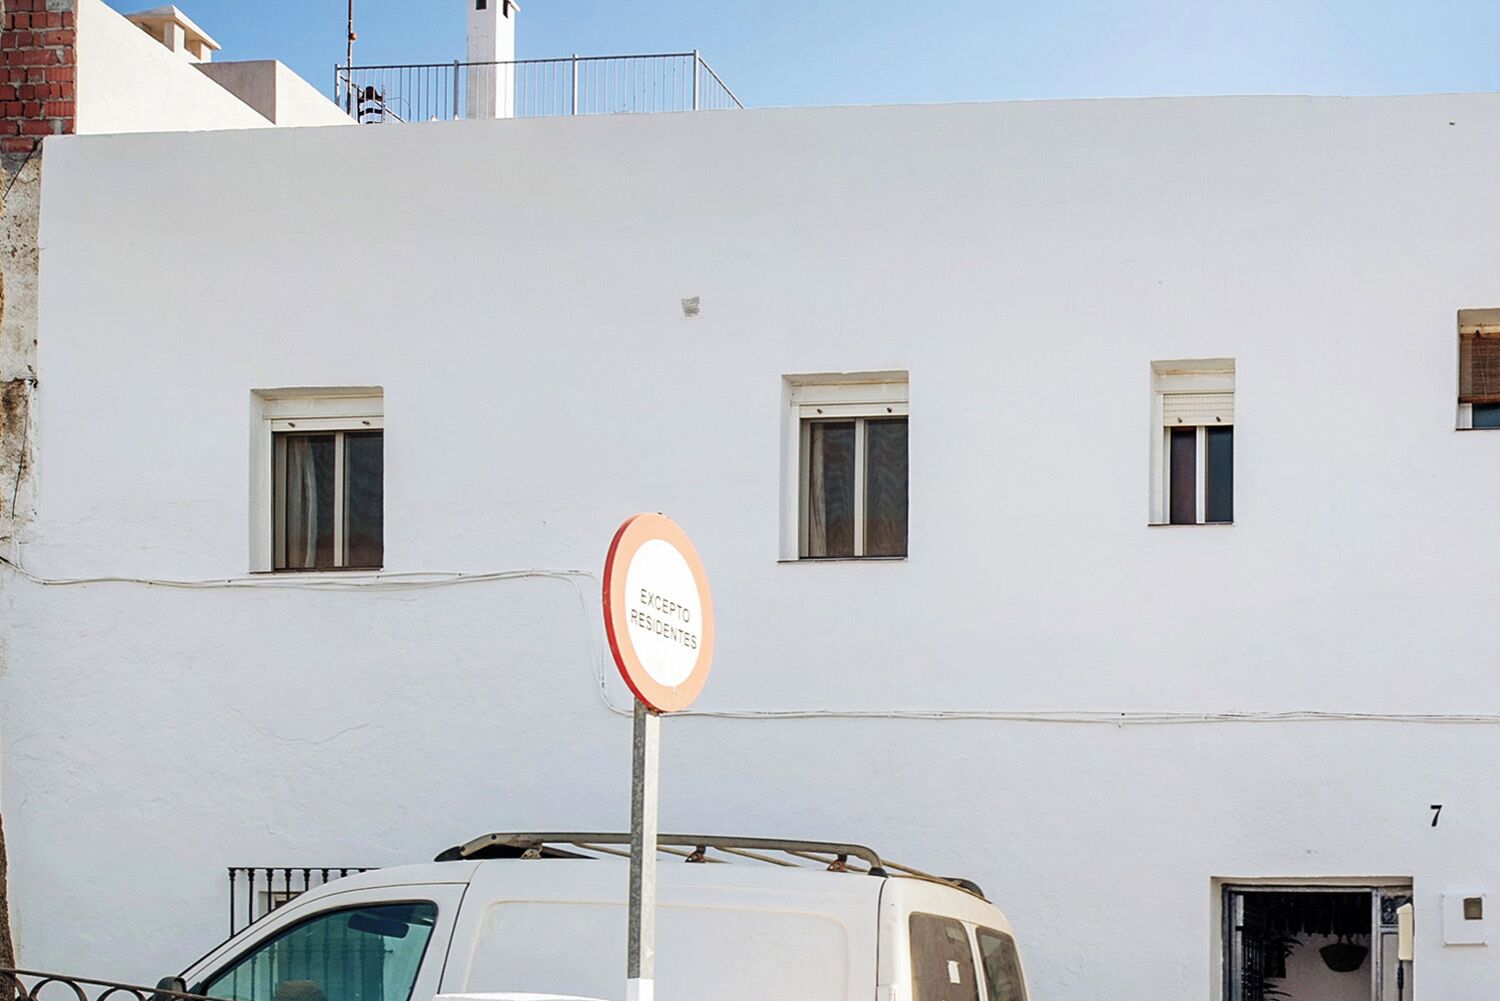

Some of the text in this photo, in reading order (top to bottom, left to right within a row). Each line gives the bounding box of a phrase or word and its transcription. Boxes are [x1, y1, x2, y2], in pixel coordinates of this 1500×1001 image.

[641, 588, 690, 623] EXCEPTO
[631, 609, 697, 649] RESIDENTES
[1430, 805, 1442, 827] 7
